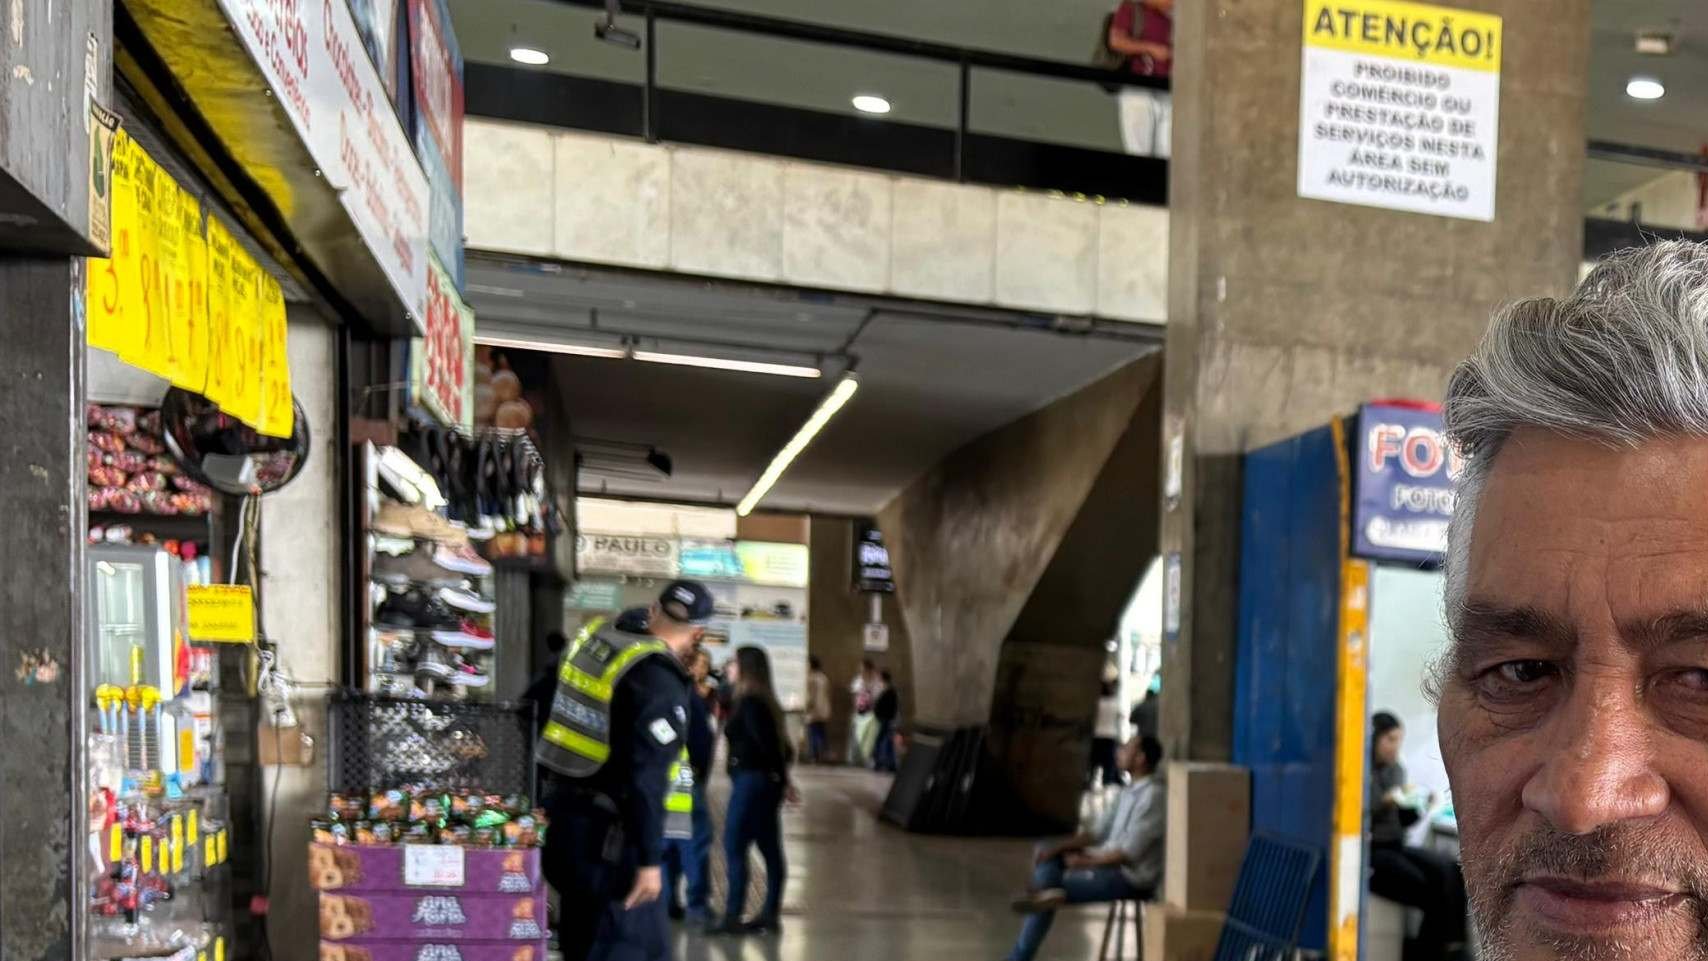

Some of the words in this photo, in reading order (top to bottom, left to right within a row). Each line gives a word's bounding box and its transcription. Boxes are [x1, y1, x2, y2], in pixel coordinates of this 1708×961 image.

[1313, 7, 1495, 60] ATENÇÃO!
[1355, 61, 1451, 89] PROIBIDO
[1326, 101, 1444, 131] PRESTAÇÃO
[1450, 118, 1476, 137] DE
[1441, 97, 1472, 114] OU
[1314, 123, 1416, 149] SERVIÇOS
[1420, 138, 1485, 159] NESTA
[1408, 157, 1451, 177] SEM
[1326, 169, 1469, 202] AUTORIZAÇÃO
